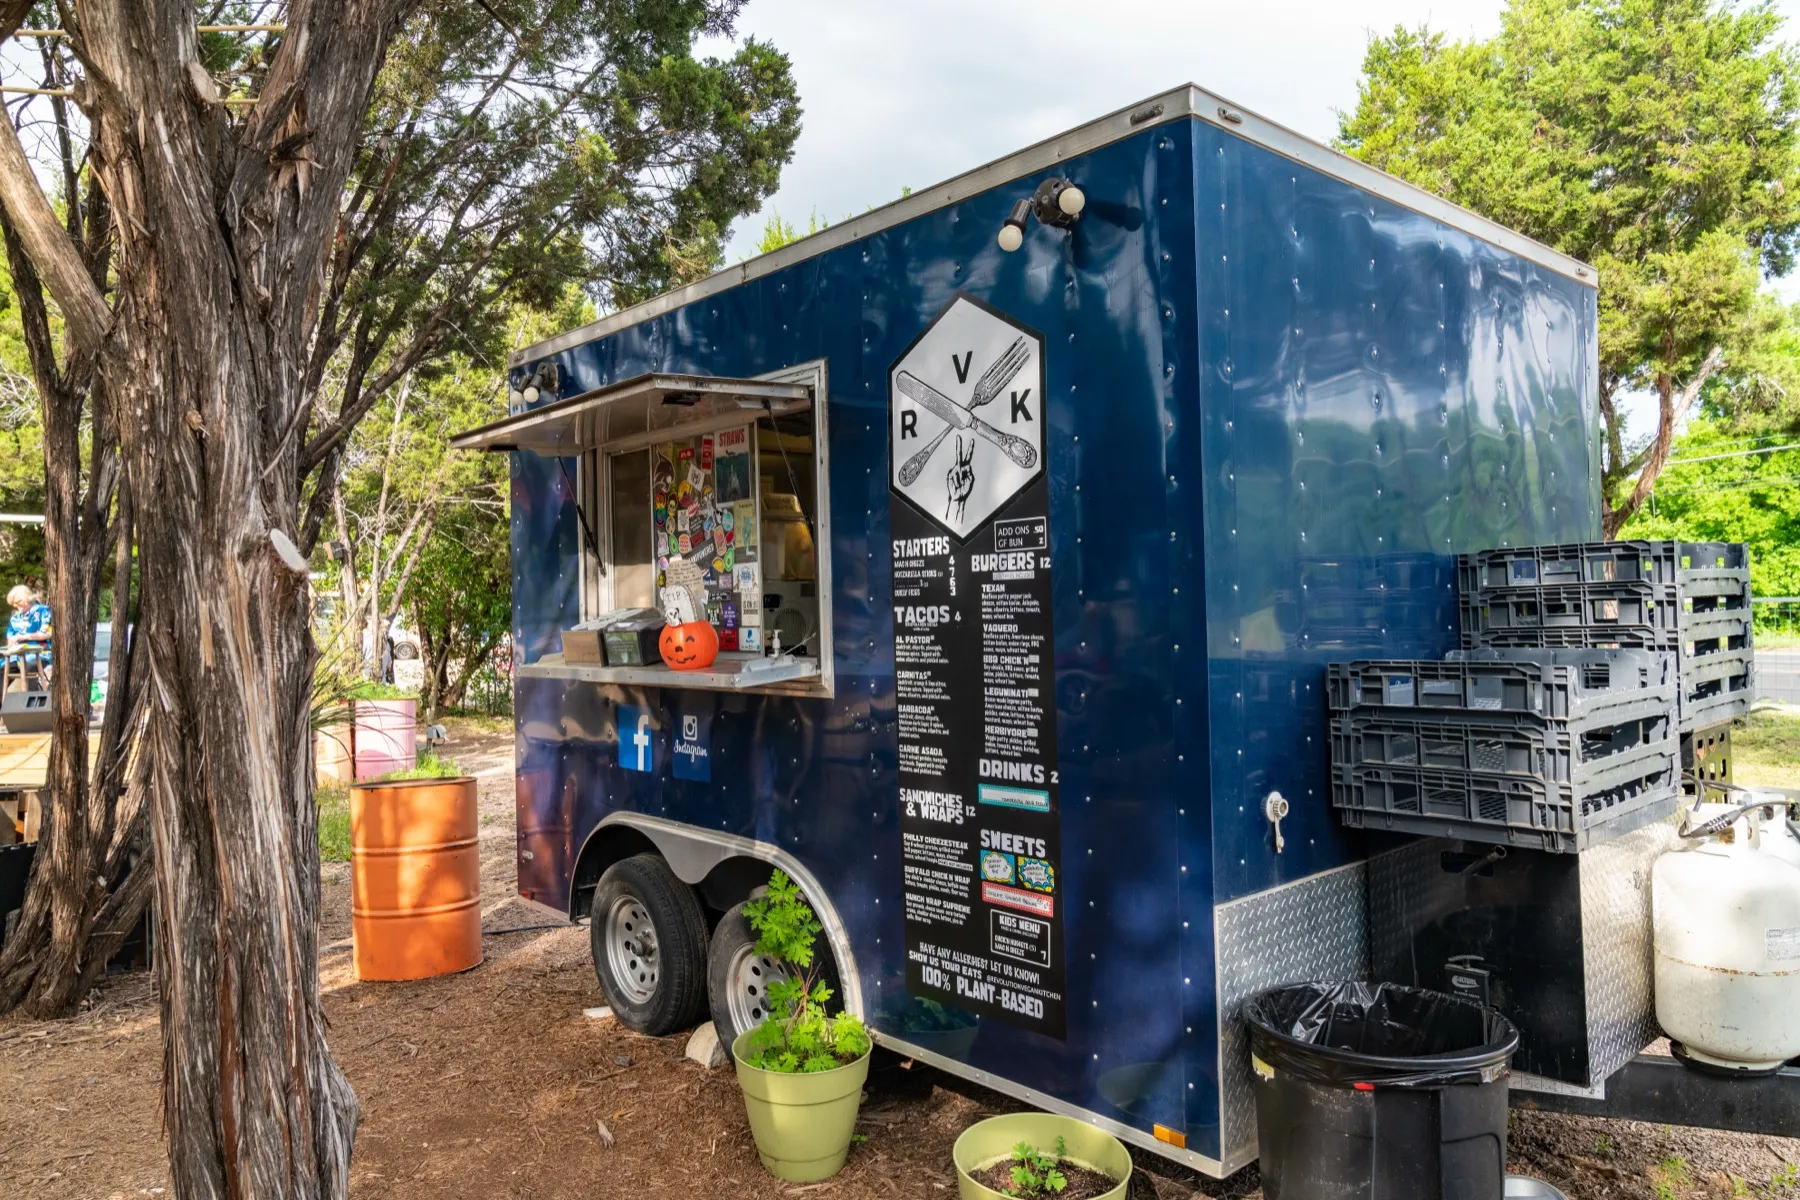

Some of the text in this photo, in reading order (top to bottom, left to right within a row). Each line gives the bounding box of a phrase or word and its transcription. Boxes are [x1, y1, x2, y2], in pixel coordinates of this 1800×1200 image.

[952, 351, 973, 384] V
[1010, 388, 1033, 424] K
[901, 410, 918, 440] R
[720, 428, 745, 448] STRAWS
[998, 526, 1013, 536] ADD
[1014, 525, 1030, 535] ONS
[893, 536, 950, 558] STARTERS
[998, 539, 1007, 548] GF
[1008, 538, 1023, 547] BUN
[949, 566, 955, 577] 7
[972, 552, 1051, 572] BURGERS 12
[950, 578, 955, 587] 6
[950, 587, 956, 596] 3
[982, 584, 1005, 592] TEXAN
[894, 605, 950, 623] TACOS
[983, 624, 1018, 633] VAQUERO
[896, 635, 931, 644] AL PASTOR
[984, 655, 998, 664] BBQ
[897, 670, 928, 680] CARNITAS
[898, 704, 931, 714] BARBACOA
[984, 725, 1027, 738] HERBIVORE
[673, 739, 708, 763] Instagram
[898, 744, 943, 757] CARNE ASADA
[980, 759, 1059, 784] DRINKS 2
[900, 788, 963, 809] SANDWICHES
[906, 802, 976, 825] & WRAPS 12
[904, 832, 969, 850] PHILLY CHEEZESTEAK
[980, 828, 1046, 858] SWEETS
[904, 865, 931, 877] BUFFALO
[954, 874, 971, 885] WRAP
[906, 892, 925, 903] MUNCH
[926, 896, 942, 907] WRAP
[943, 900, 971, 914] SUPREME
[999, 915, 1040, 934] KIDS MENU
[920, 942, 1040, 985] HAVE ANY ALLERGIES? LET US KNOW!
[1040, 950, 1047, 960] 7
[909, 950, 1061, 1001] SHOW US YOUR EATS @REVOLUTIONVEGANKITCHEN
[922, 965, 1044, 1019] 100% PLANT-BASED
